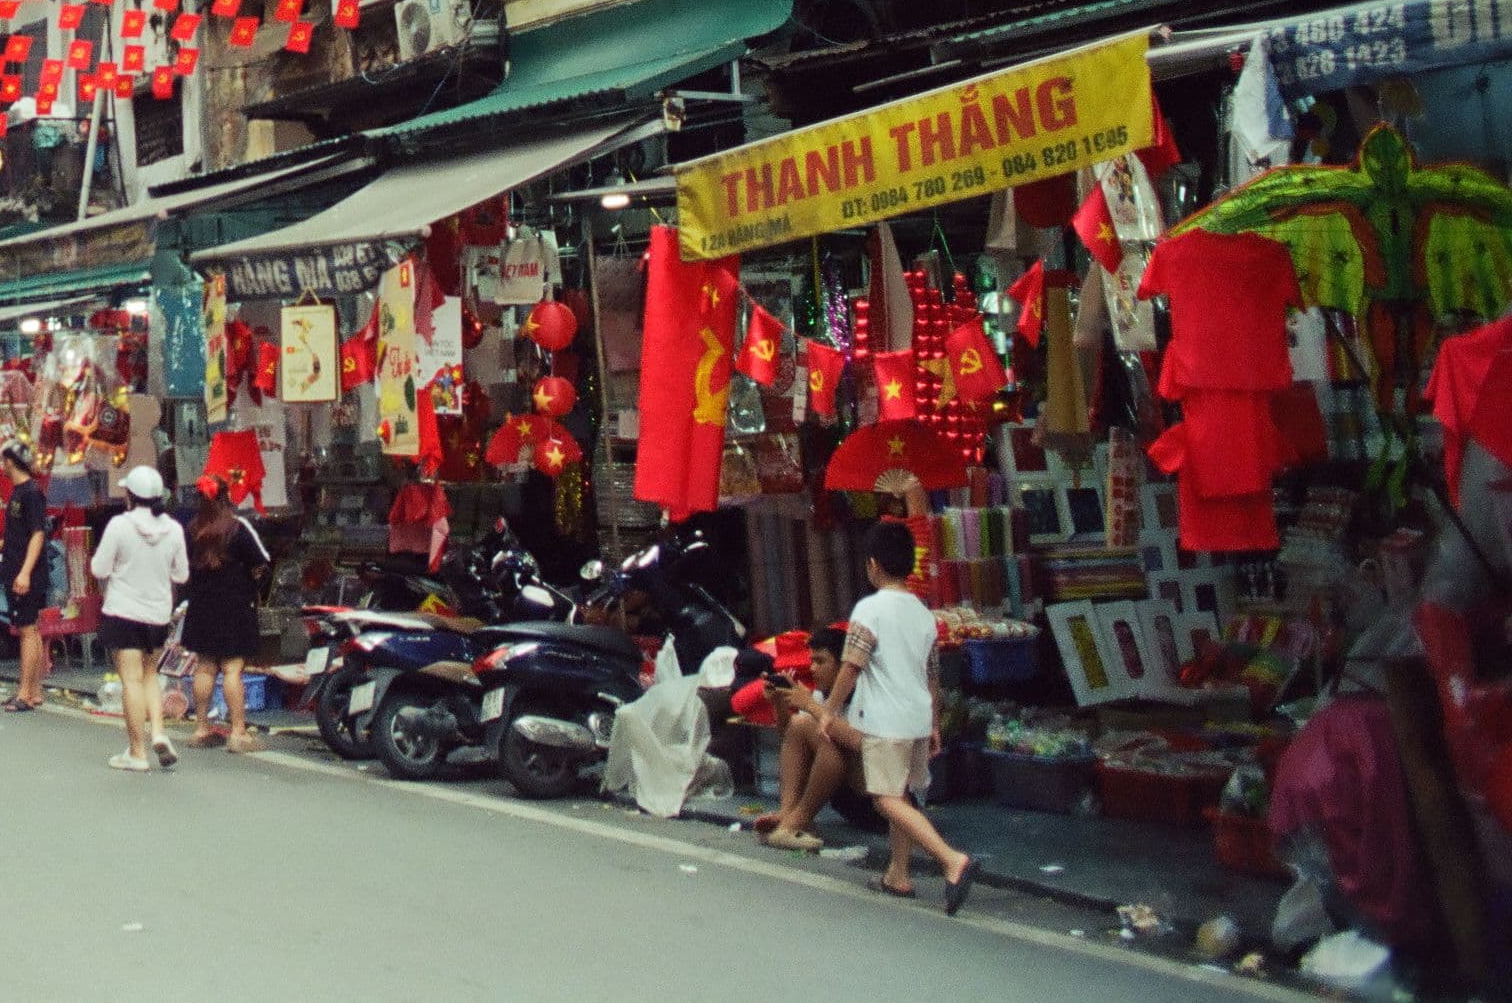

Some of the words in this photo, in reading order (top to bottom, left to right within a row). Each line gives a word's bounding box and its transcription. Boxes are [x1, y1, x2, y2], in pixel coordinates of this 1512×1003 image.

[721, 135, 877, 219] THANH
[889, 76, 1078, 174] THẮNG
[232, 256, 292, 296] HÀNG
